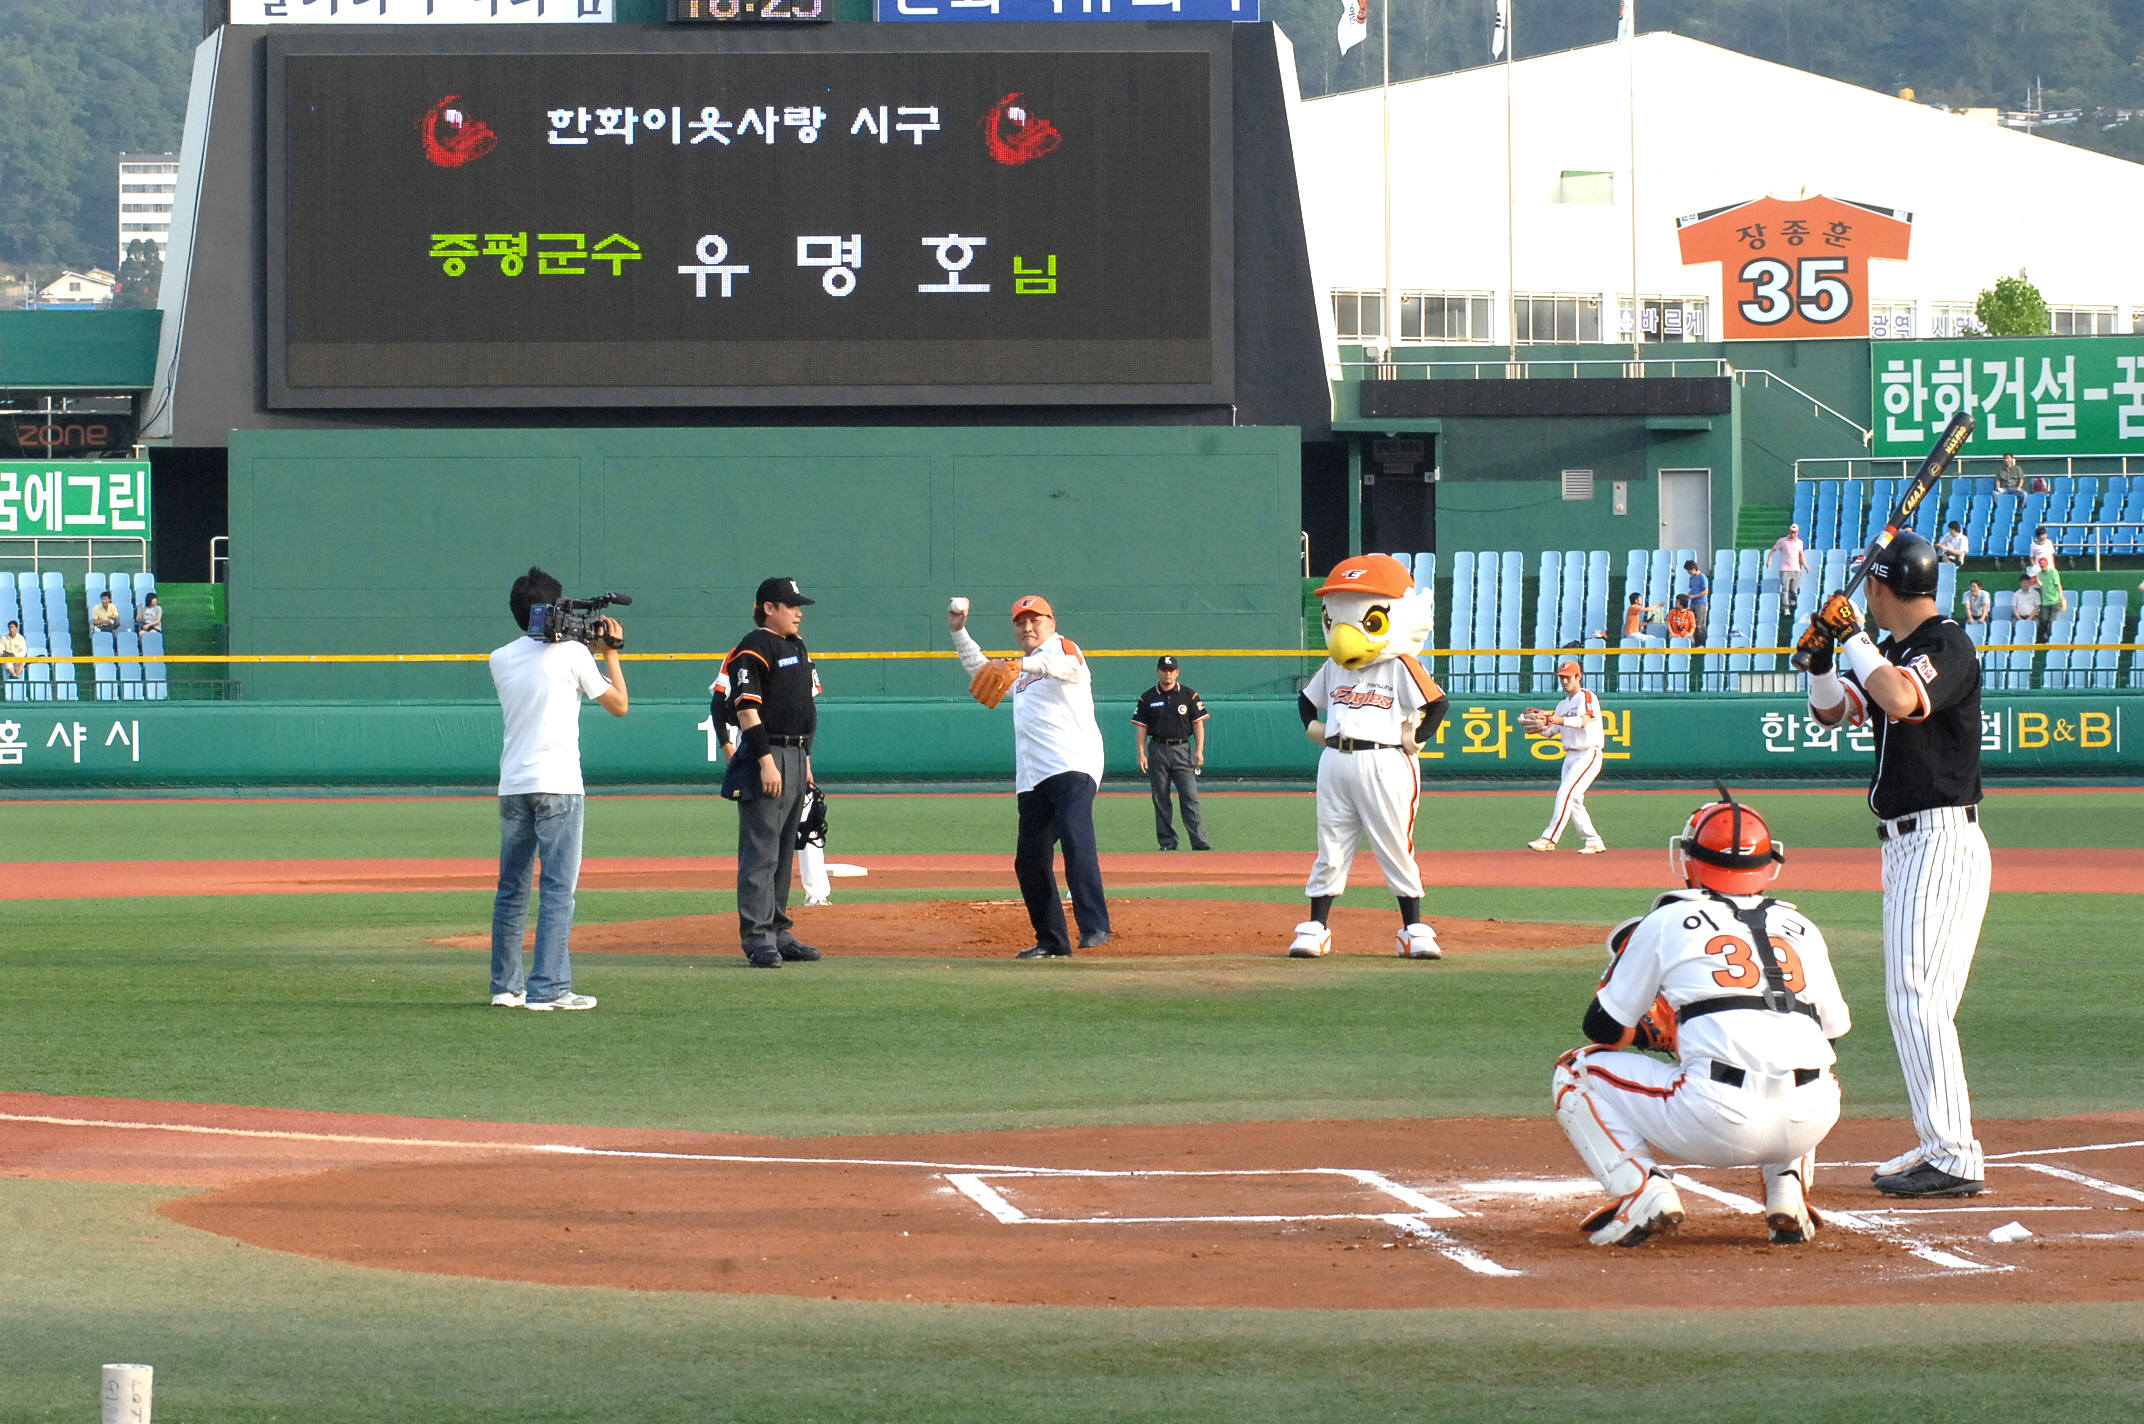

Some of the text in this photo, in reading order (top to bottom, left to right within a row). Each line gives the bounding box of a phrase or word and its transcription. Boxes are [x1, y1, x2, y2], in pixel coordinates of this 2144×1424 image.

[547, 105, 940, 145] 한화이웃사랑 시구
[429, 232, 642, 277] 증평군수
[1738, 256, 1853, 326] 35
[1330, 685, 1394, 710] Eagles
[1704, 934, 1807, 993] 39
